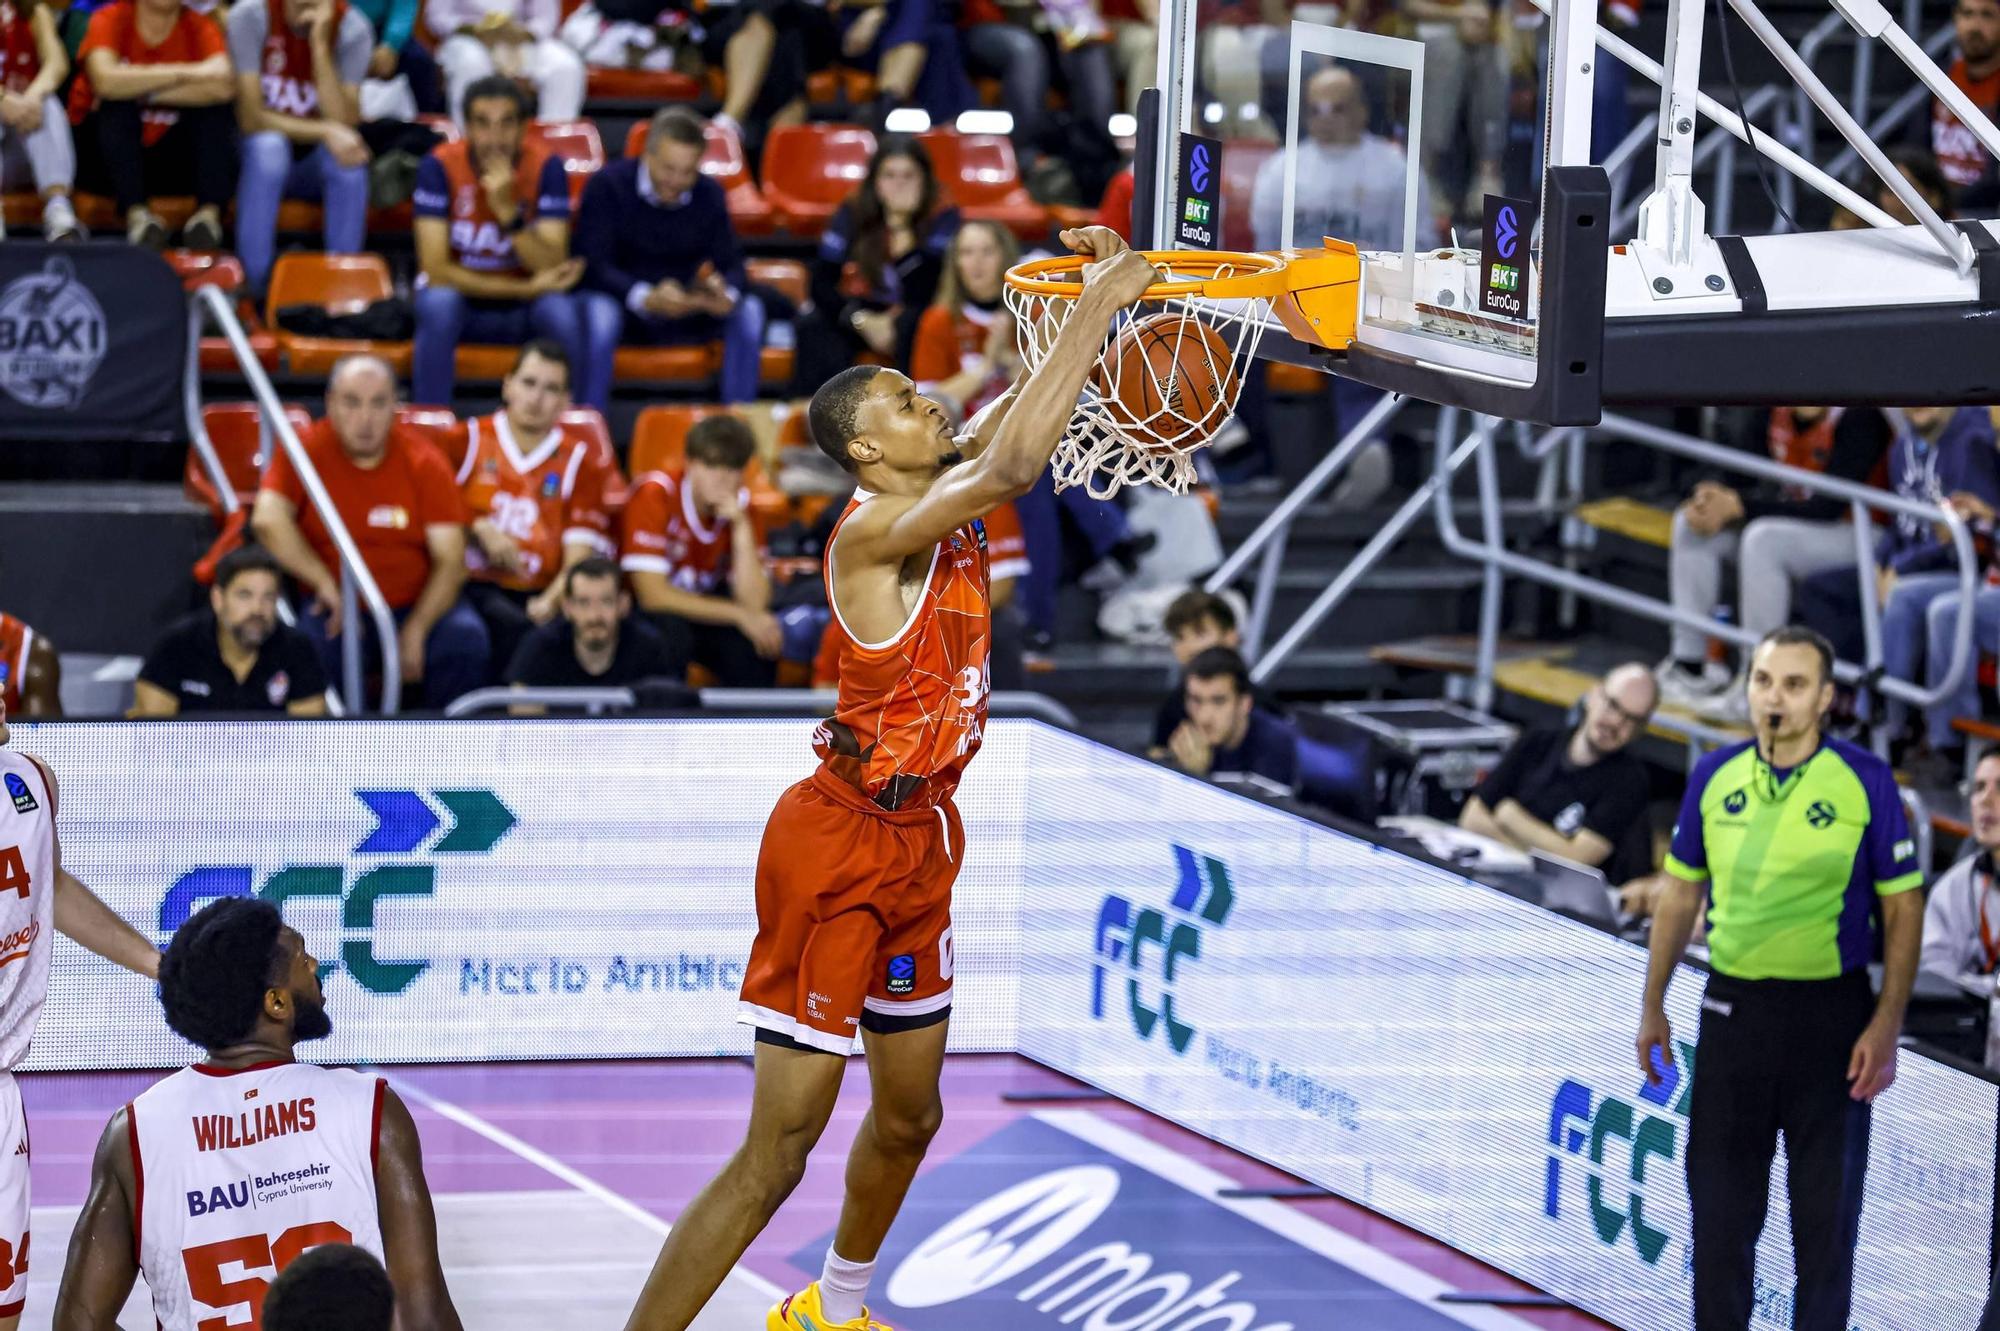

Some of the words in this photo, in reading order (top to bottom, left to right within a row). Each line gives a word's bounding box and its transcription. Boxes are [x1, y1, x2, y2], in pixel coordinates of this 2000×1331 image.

[1185, 199, 1210, 221] BKT
[1182, 222, 1211, 246] EuroCup
[1490, 266, 1519, 288] BKT
[1487, 290, 1520, 314] EuroCup
[0, 319, 100, 351] BAXI
[1092, 893, 1201, 1055] FCC
[192, 1097, 316, 1152] WILLIAMS
[255, 1162, 331, 1189] Bahçeşehir
[1544, 1078, 1678, 1266] FCC
[186, 1180, 249, 1217] BAU
[257, 1188, 288, 1203] Cyprus
[289, 1178, 333, 1194] University
[1015, 1241, 1296, 1331] moto
